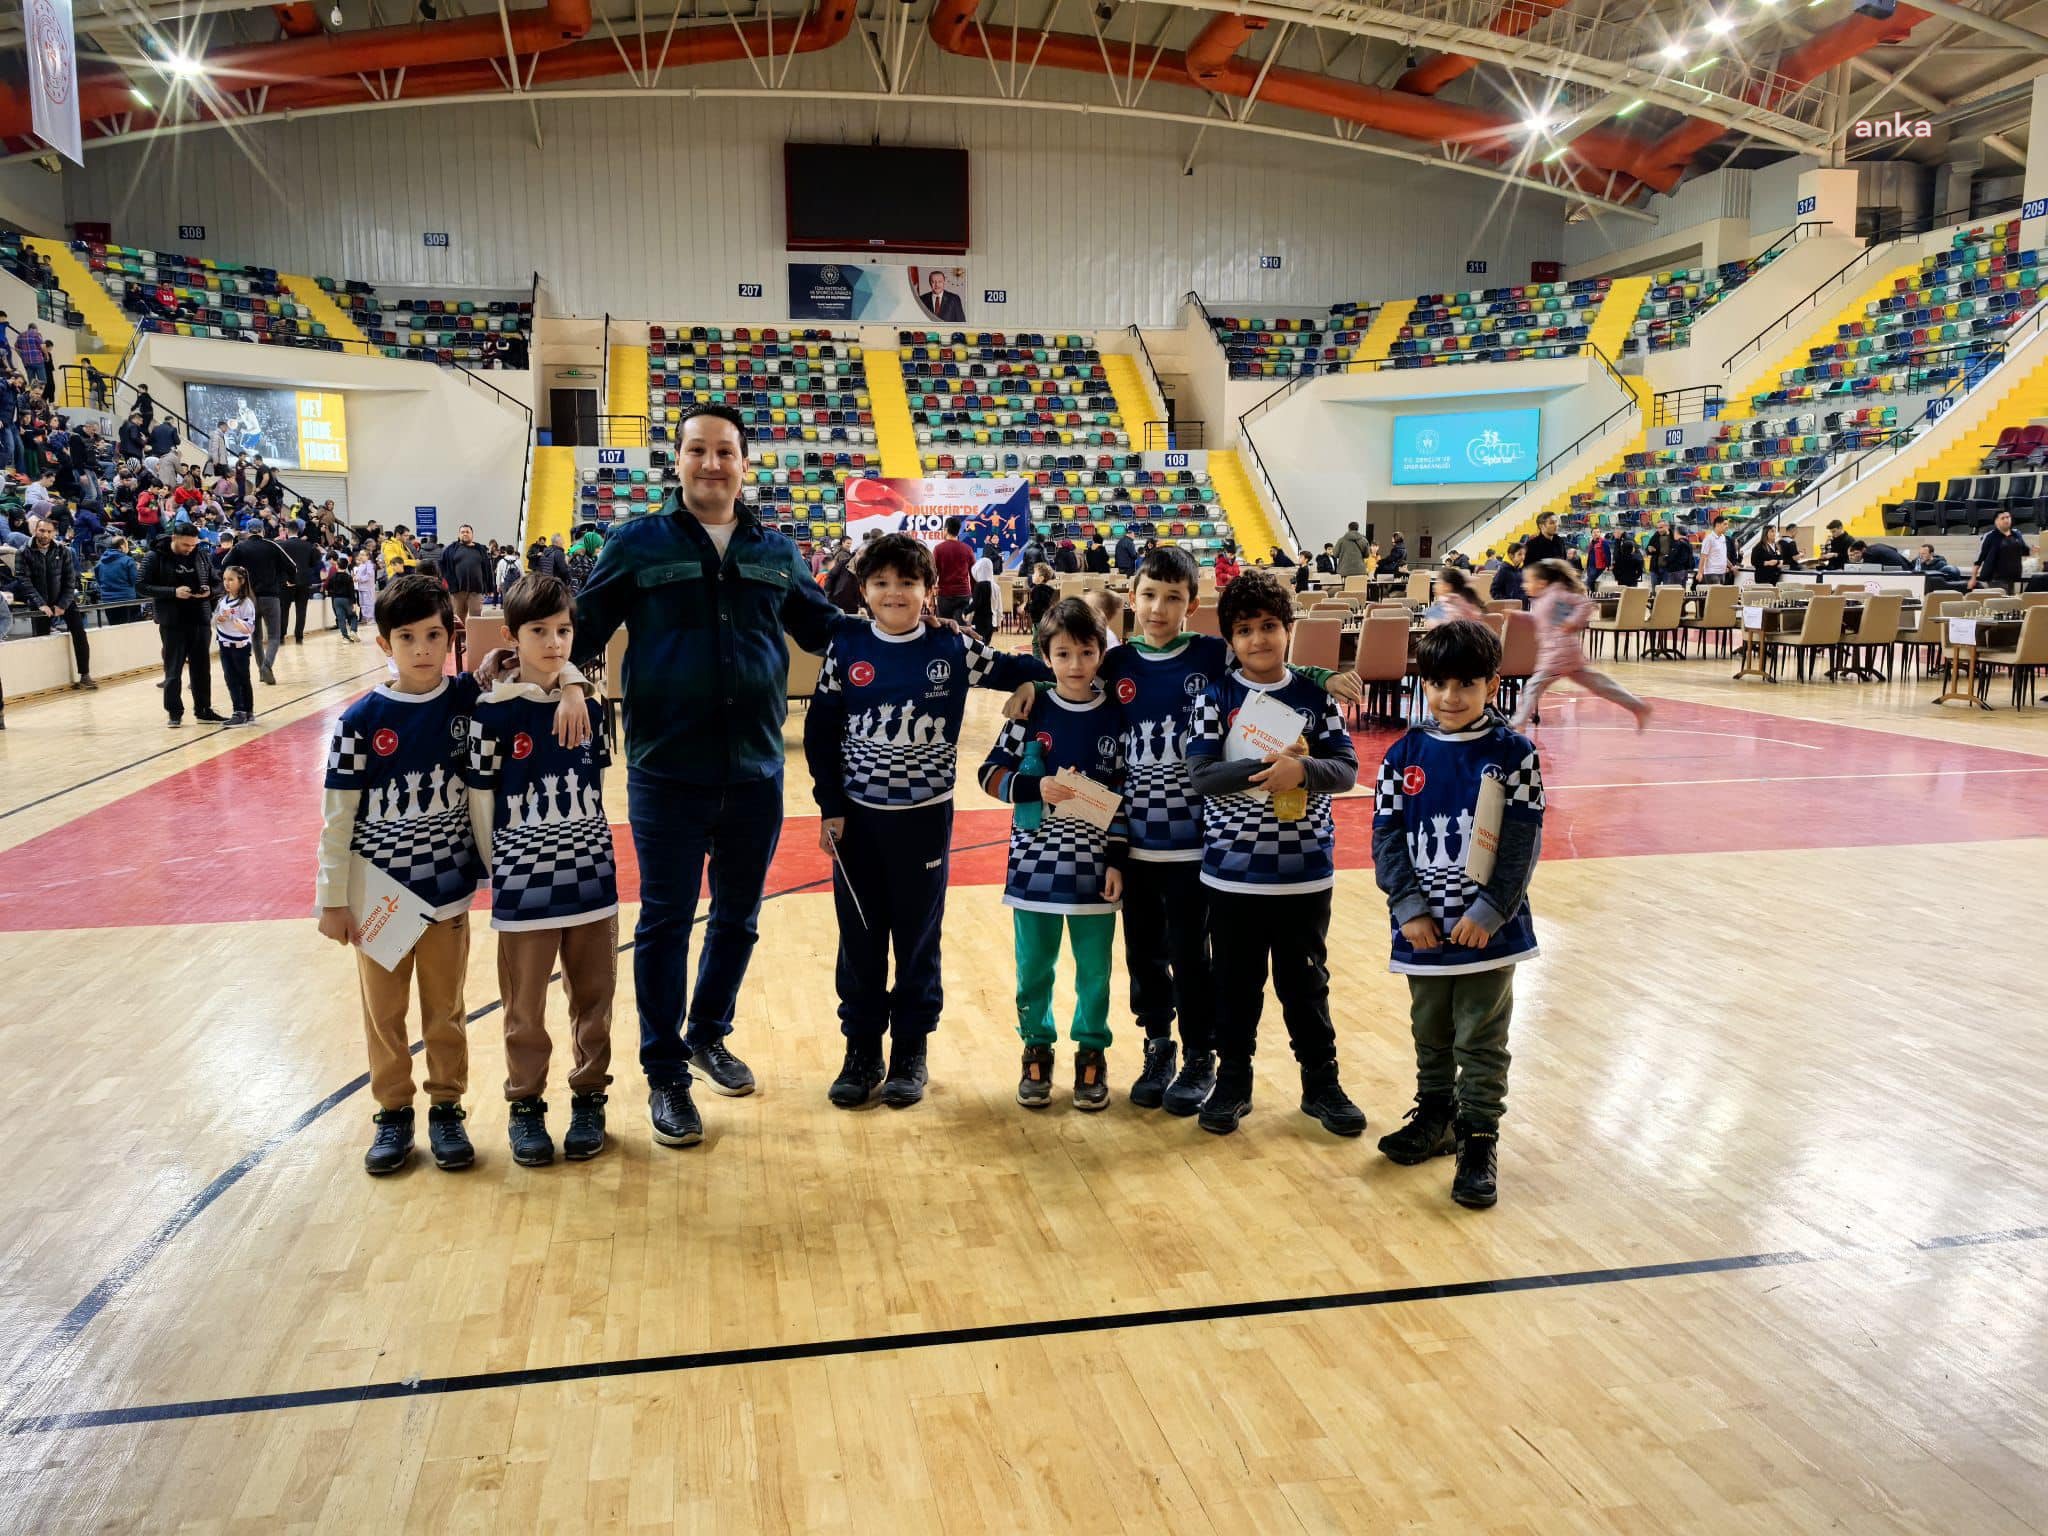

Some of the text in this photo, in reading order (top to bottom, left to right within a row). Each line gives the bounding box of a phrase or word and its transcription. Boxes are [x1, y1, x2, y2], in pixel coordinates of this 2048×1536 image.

[1799, 198, 1814, 213] 312
[2024, 200, 2045, 219] 209
[182, 226, 202, 239] 308
[426, 233, 447, 245] 309
[1262, 256, 1279, 268] 310
[1469, 262, 1485, 273] 311
[741, 284, 760, 297] 207
[987, 291, 1005, 302] 208
[1668, 430, 1681, 445] 109
[600, 450, 622, 463] 107
[1167, 454, 1185, 466] 108
